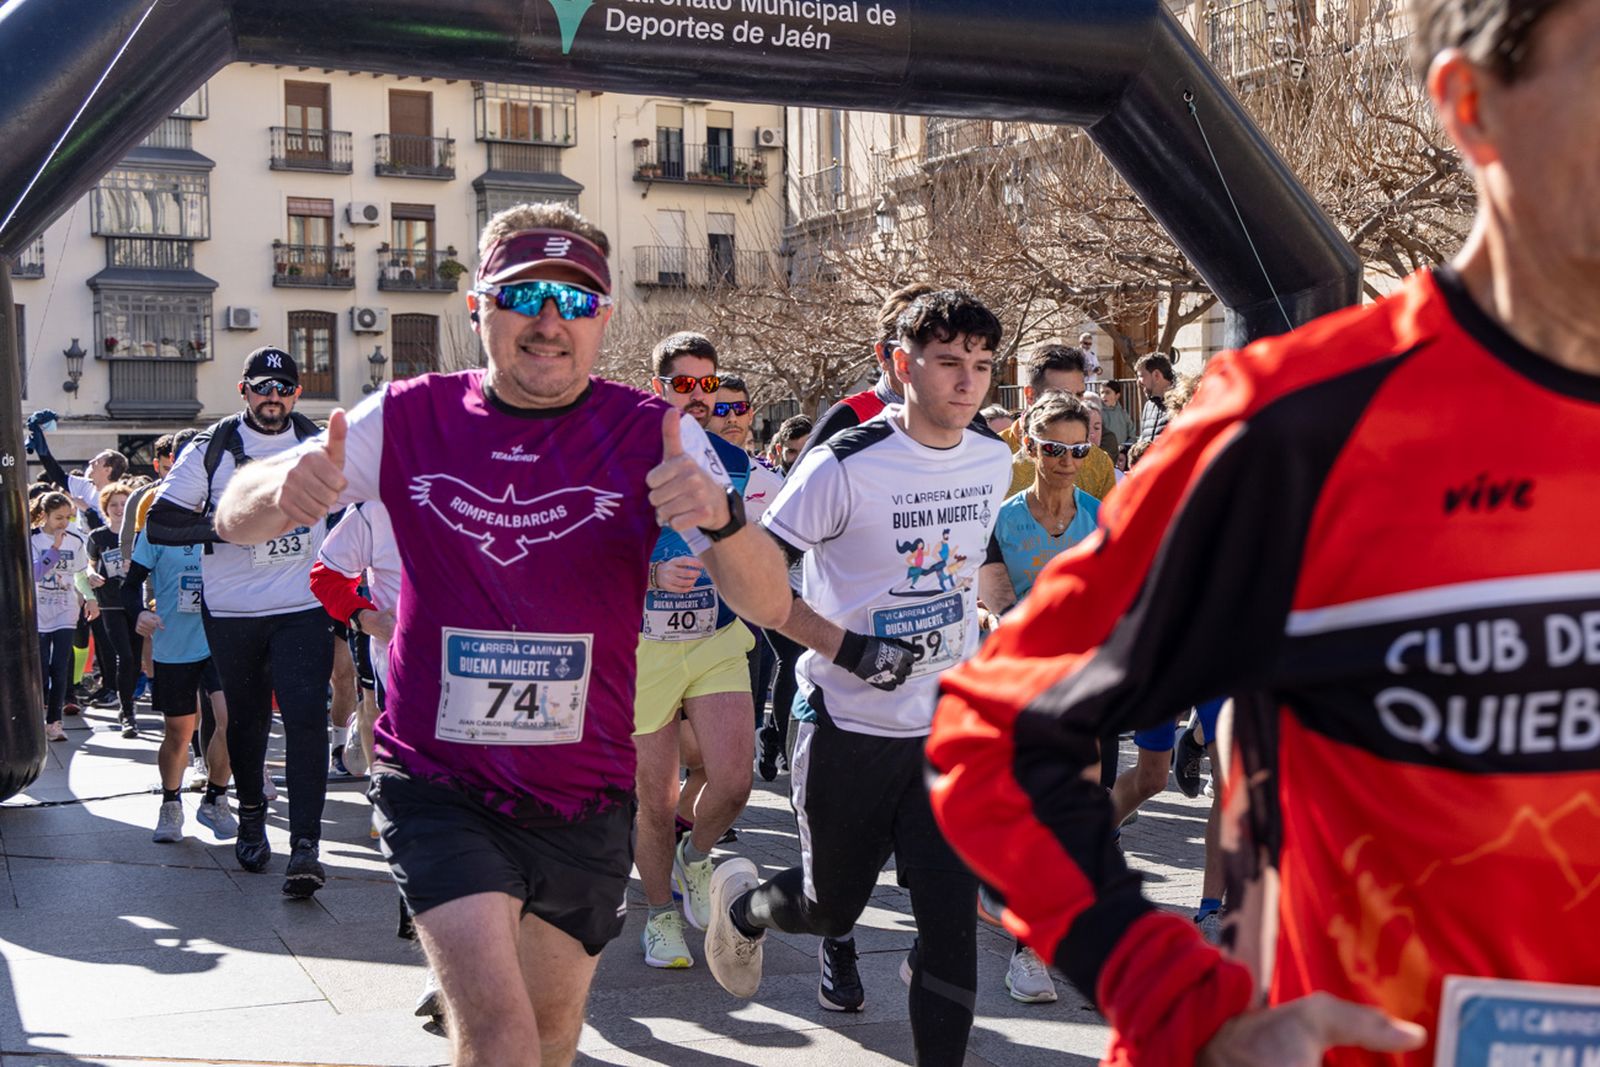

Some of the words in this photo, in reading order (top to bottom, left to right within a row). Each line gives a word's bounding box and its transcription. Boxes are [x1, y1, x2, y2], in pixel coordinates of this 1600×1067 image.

[741, 0, 858, 26] Municipal
[866, 4, 896, 26] de
[605, 8, 725, 40] Deportes
[732, 20, 764, 44] de
[772, 23, 831, 50] Jaén
[1, 453, 15, 467] de
[892, 494, 903, 505] VI
[905, 489, 952, 504] CARRERA
[449, 495, 569, 529] ROMPEALBARCAS
[892, 509, 934, 530] BUENA
[937, 503, 979, 526] MUERTE
[265, 535, 302, 556] 233
[667, 611, 696, 630] 40
[885, 621, 914, 636] BUENA
[914, 613, 944, 630] MUERTE
[460, 641, 471, 651] VI
[472, 642, 519, 655] CARRERA
[522, 645, 573, 656] CAMINATA
[1385, 617, 1528, 674] CLUB
[459, 656, 497, 675] BUENA
[501, 659, 550, 677] MUERTE
[485, 681, 540, 720] 74
